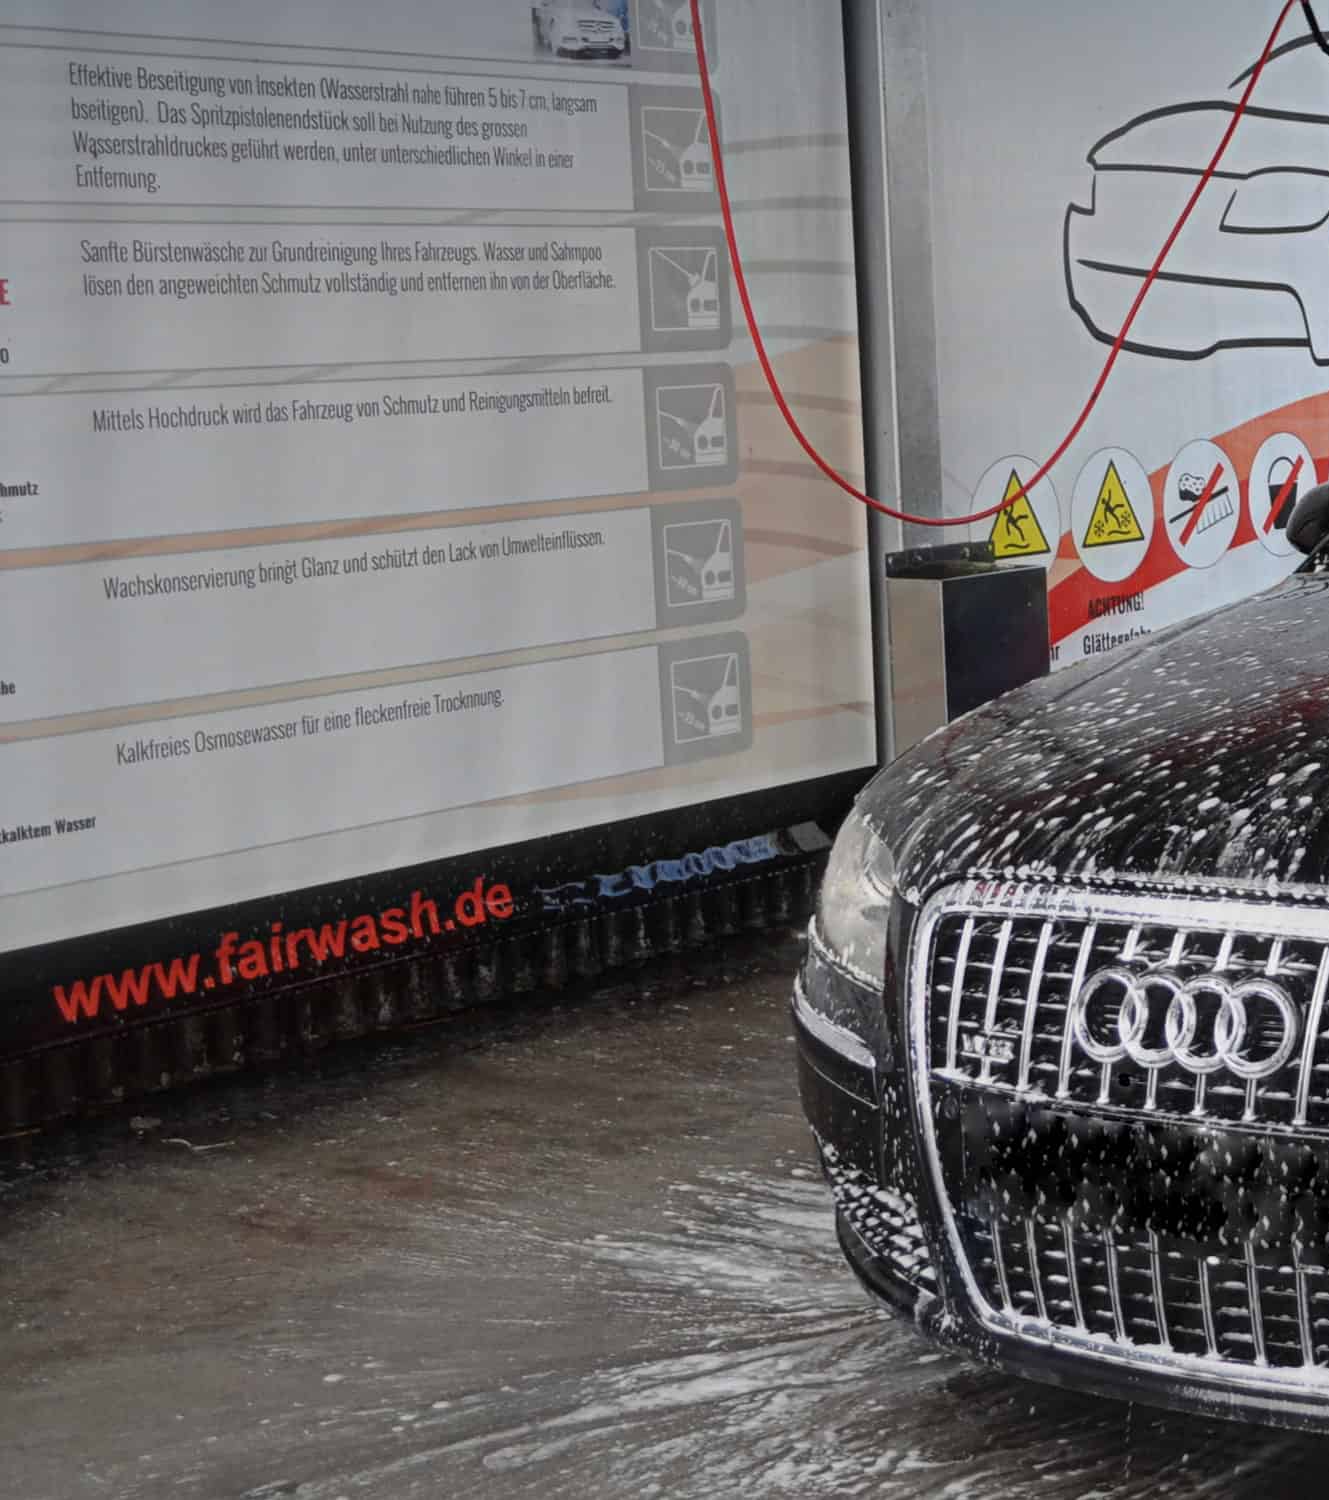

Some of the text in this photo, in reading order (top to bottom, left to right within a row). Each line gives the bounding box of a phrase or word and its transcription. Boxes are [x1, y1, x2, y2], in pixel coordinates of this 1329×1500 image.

[69, 62, 133, 90] Effektive
[137, 67, 226, 98] Beseitigung
[229, 78, 253, 94] von
[256, 74, 316, 98] Insekten
[320, 77, 409, 103] (Wasserstrahl
[412, 86, 441, 105] nahe
[445, 88, 486, 108] führen
[488, 90, 498, 108] 5
[500, 91, 518, 109] bis
[551, 94, 597, 116] langsam
[157, 100, 187, 125] Das
[190, 102, 349, 132] Spritzpistolenendstück
[353, 113, 376, 132] soll
[379, 112, 399, 133] bei
[402, 115, 453, 139] Nutzung
[456, 118, 479, 137] des
[482, 122, 527, 141] grossen
[72, 130, 574, 169] Wasserstrahldruckes geführt werden, unter unterschiedlichen Winkel in einer
[75, 164, 161, 193] Entfernung.
[81, 240, 128, 263] Sanfte
[133, 240, 244, 264] Bürstenwäsche
[249, 245, 268, 262] zur
[271, 240, 377, 266] Grundreinigung
[381, 241, 412, 262] Ihres
[483, 241, 525, 261] Wasser
[528, 242, 548, 260] und
[84, 274, 122, 296] lösen
[127, 274, 154, 296] den
[159, 273, 258, 300] angeweichten
[262, 272, 320, 294] Schmutz
[325, 271, 397, 296] vollständig
[401, 272, 424, 292] und
[427, 271, 487, 292] entfernen
[490, 271, 508, 290] ihn
[511, 275, 531, 290] von
[533, 272, 549, 290] der
[92, 407, 144, 432] Mittels
[148, 405, 229, 430] Hochdruck
[232, 403, 262, 424] wird
[265, 402, 288, 422] das
[292, 399, 353, 422] Fahrzeug
[357, 401, 380, 418] von
[383, 395, 440, 416] Schmutz
[442, 392, 465, 413] und
[469, 386, 571, 413] Reinigungsmitteln
[103, 567, 256, 600] Wachskonservierung
[258, 559, 298, 584] bringt
[302, 557, 339, 578] Glanz
[343, 552, 368, 574] und
[372, 548, 418, 571] schützt
[422, 545, 446, 566] den
[449, 540, 477, 562] Lack
[480, 543, 500, 559] von
[116, 736, 191, 765] Kalkfreies
[194, 721, 297, 753] Osmosewasser
[301, 714, 320, 736] für
[324, 710, 351, 733] eine
[354, 698, 431, 728] fleckenfreie
[54, 815, 96, 835] Wasser
[52, 874, 517, 1024] www.fairwash.de
